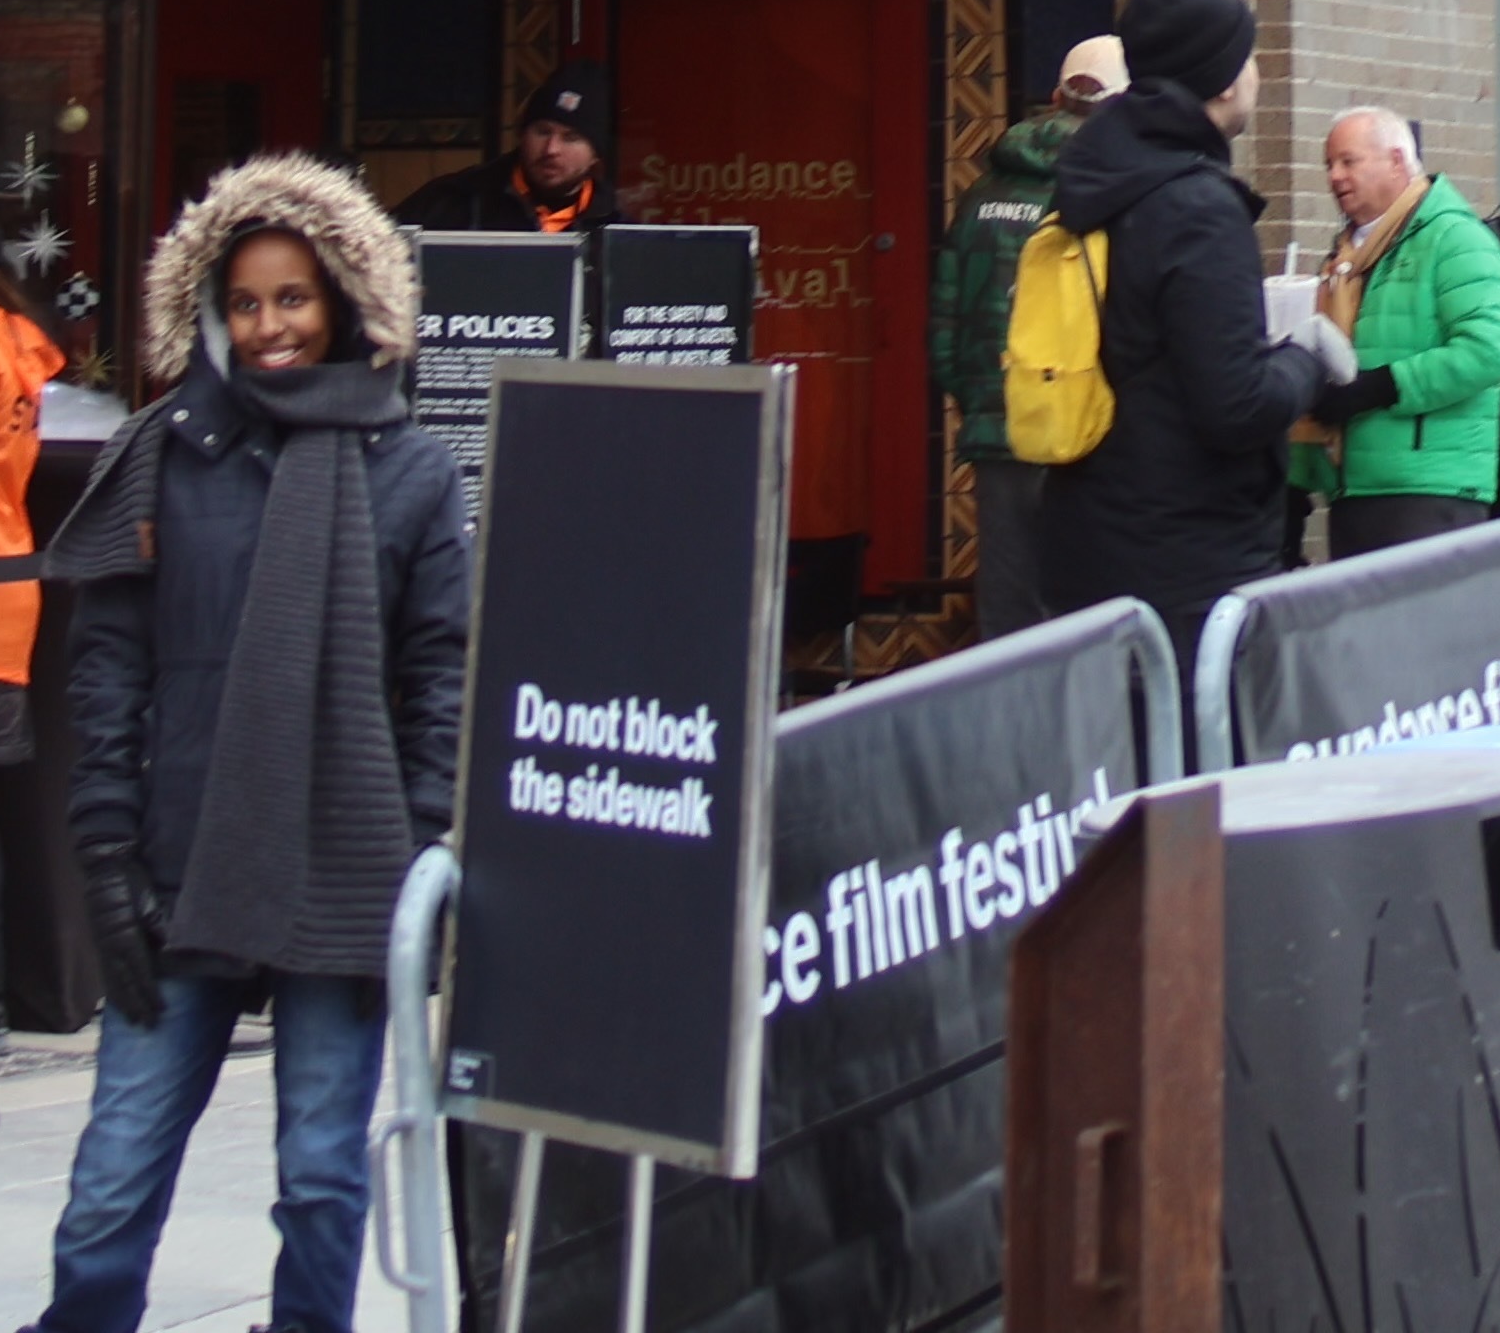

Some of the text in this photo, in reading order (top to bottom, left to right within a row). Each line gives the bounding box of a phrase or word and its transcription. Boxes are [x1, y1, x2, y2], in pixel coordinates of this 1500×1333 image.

[642, 152, 857, 192] Sundance
[977, 202, 1043, 222] KENNETH
[448, 315, 555, 339] POLICIES
[514, 683, 719, 764] Do not block
[509, 755, 714, 839] the sidewalk
[826, 857, 940, 990] film
